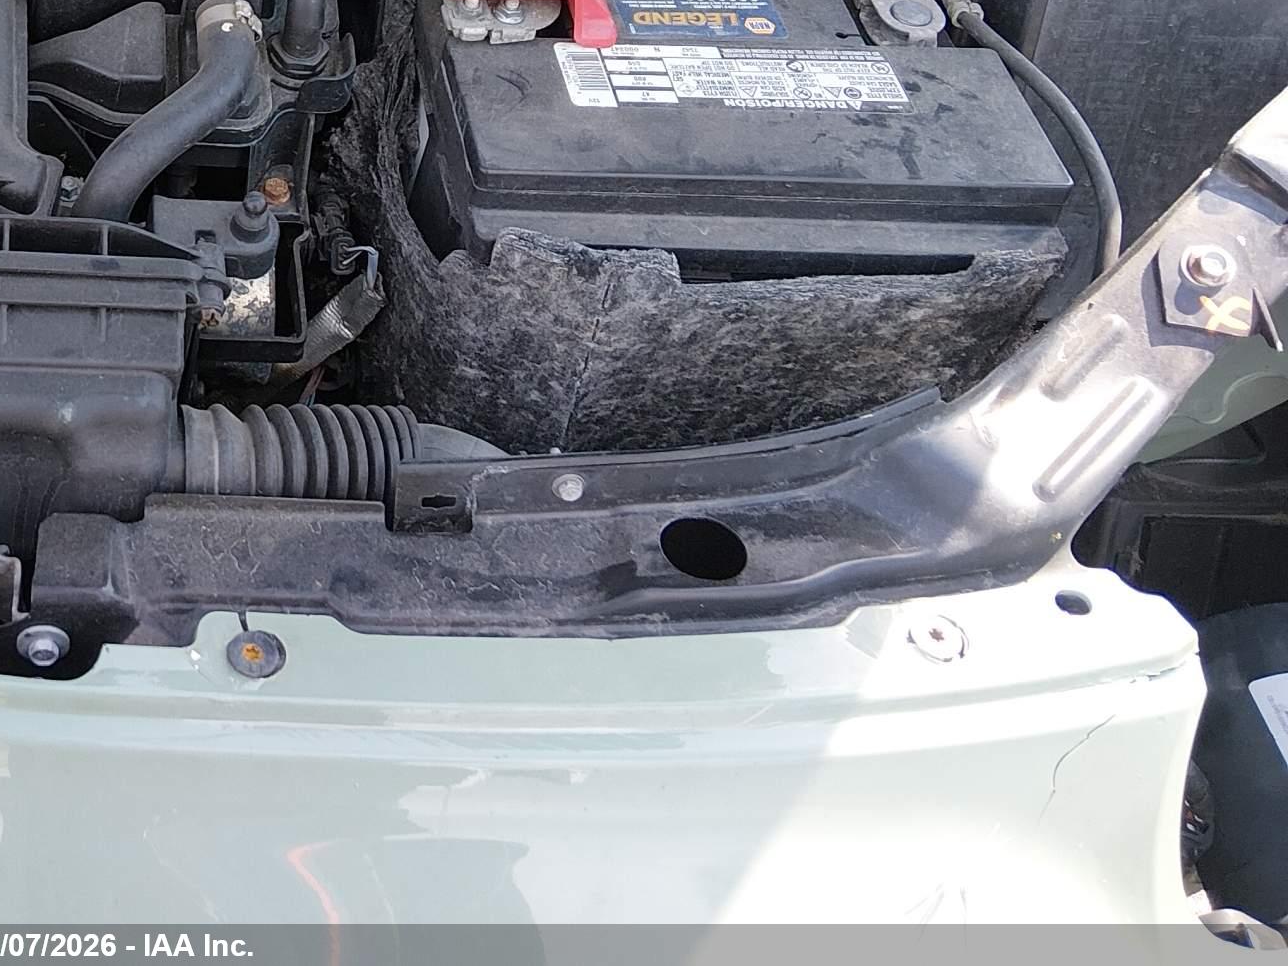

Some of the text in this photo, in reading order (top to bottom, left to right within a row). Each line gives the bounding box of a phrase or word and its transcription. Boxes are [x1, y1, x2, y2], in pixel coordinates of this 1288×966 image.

[632, 11, 739, 26] LEGEND
[749, 21, 772, 30] NAPA
[723, 99, 848, 108] DANGER/POISON
